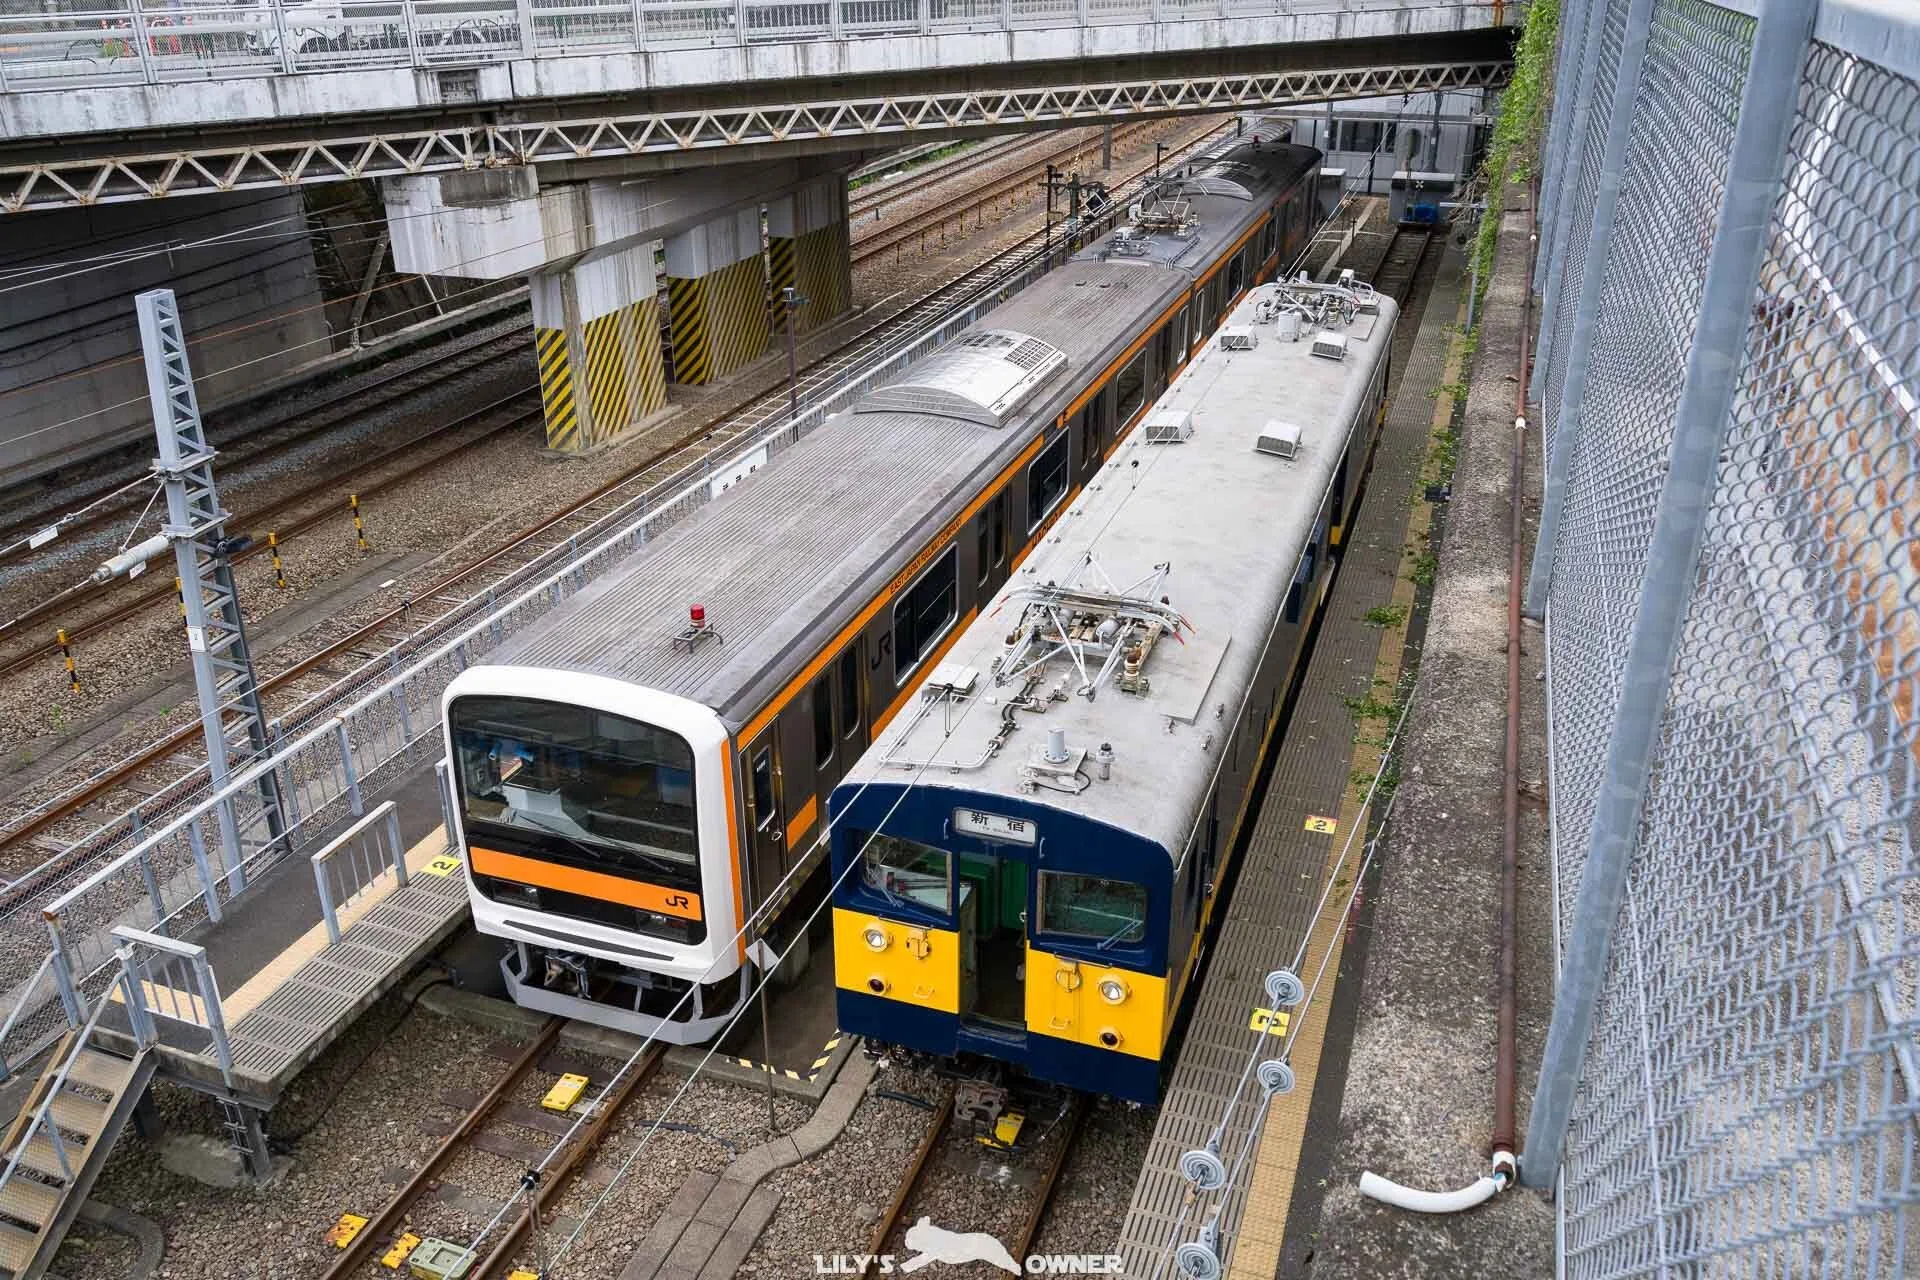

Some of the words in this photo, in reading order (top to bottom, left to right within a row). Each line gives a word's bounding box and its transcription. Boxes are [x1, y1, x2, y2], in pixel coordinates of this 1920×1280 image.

[871, 630, 891, 670] JR
[971, 811, 1025, 832] 新宿
[1314, 819, 1327, 831] 2
[432, 861, 453, 870] 2
[665, 895, 689, 910] JR
